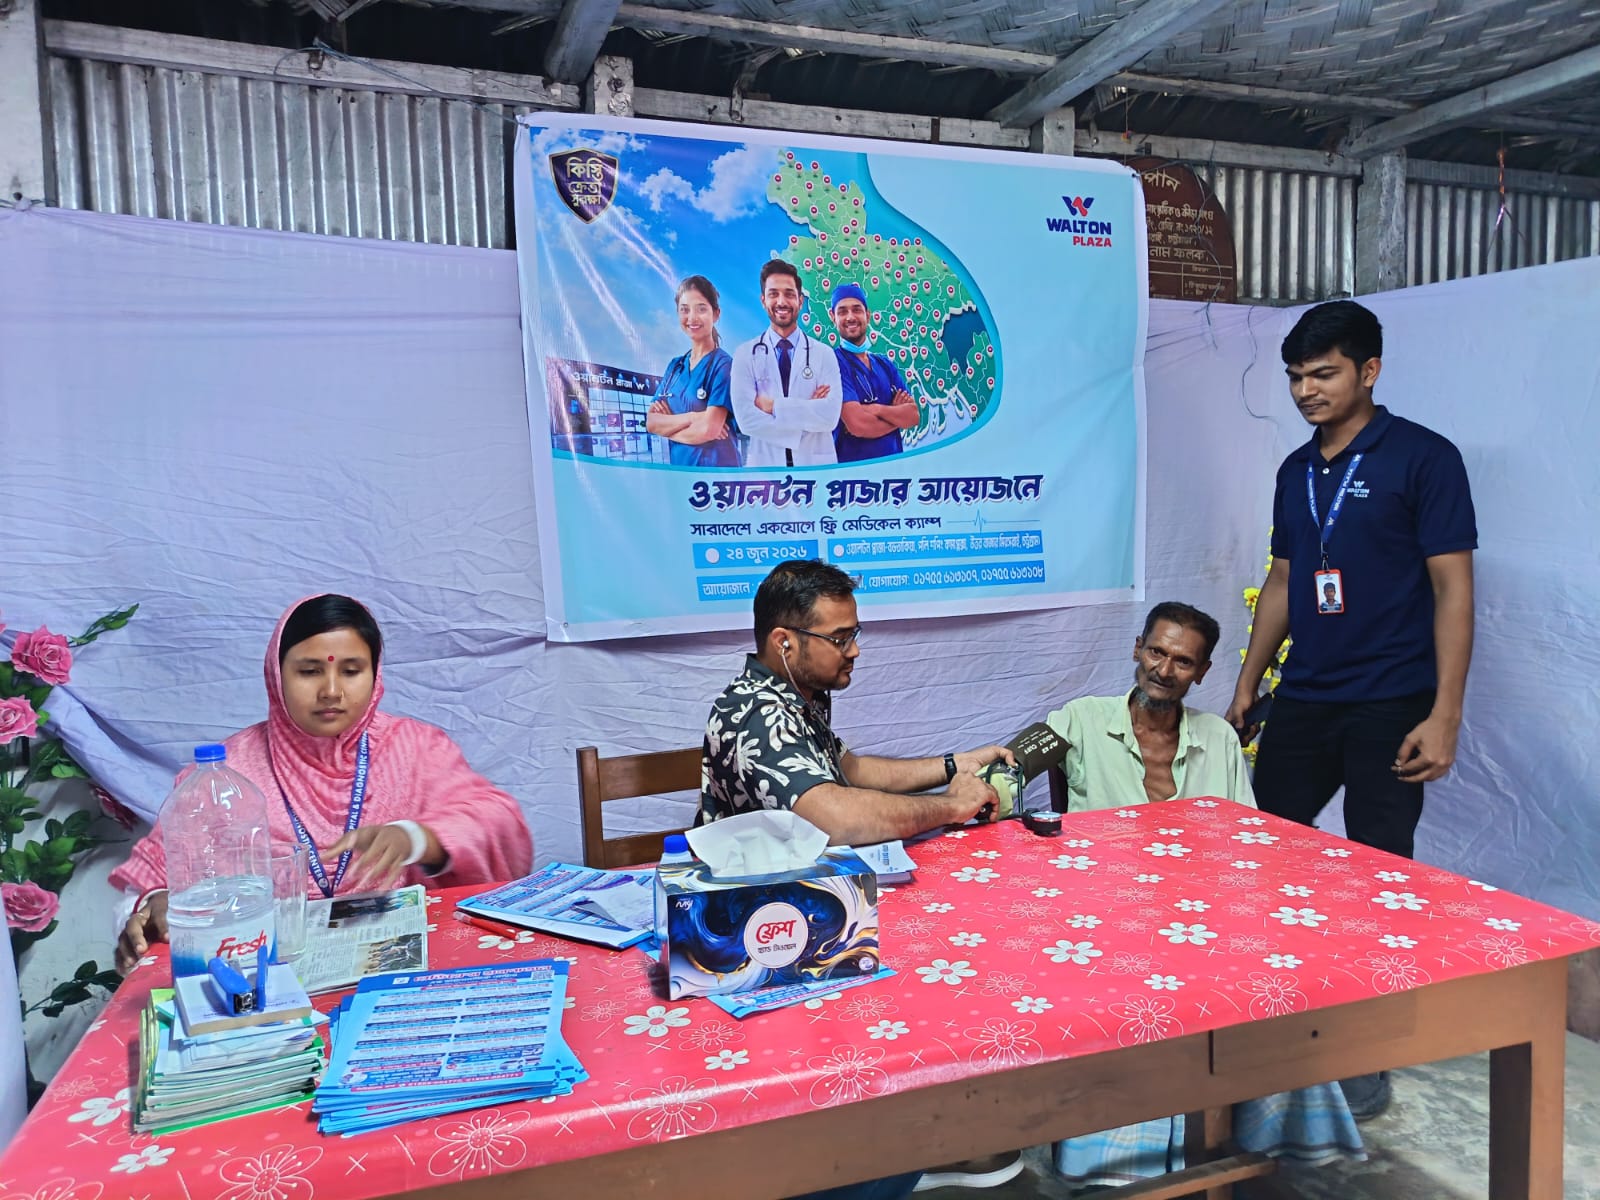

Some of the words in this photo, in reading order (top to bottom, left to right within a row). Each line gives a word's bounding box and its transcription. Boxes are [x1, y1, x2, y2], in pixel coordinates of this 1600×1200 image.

[1046, 218, 1112, 235] WALTON
[1073, 235, 1112, 247] PLAZA
[688, 475, 814, 509] ওয়ালটন
[824, 479, 911, 509] প্লাজার
[917, 475, 1043, 503] আয়োজনে
[689, 523, 751, 536] সারাদেশে
[756, 520, 815, 535] একযোগে
[819, 515, 837, 535] ফ্রি
[841, 514, 901, 532] মেডিকেল
[903, 517, 942, 530] ক্যাম্প
[726, 547, 744, 560] ২৪
[745, 547, 770, 564] জুন
[771, 545, 808, 559] ২০২৬
[913, 571, 942, 585] ০১৭৫৫
[980, 567, 1010, 581] ০১৭৫৫
[701, 582, 750, 597] আয়োজনে
[756, 920, 797, 944] ফ্রেশ
[216, 929, 267, 959] Fresh
